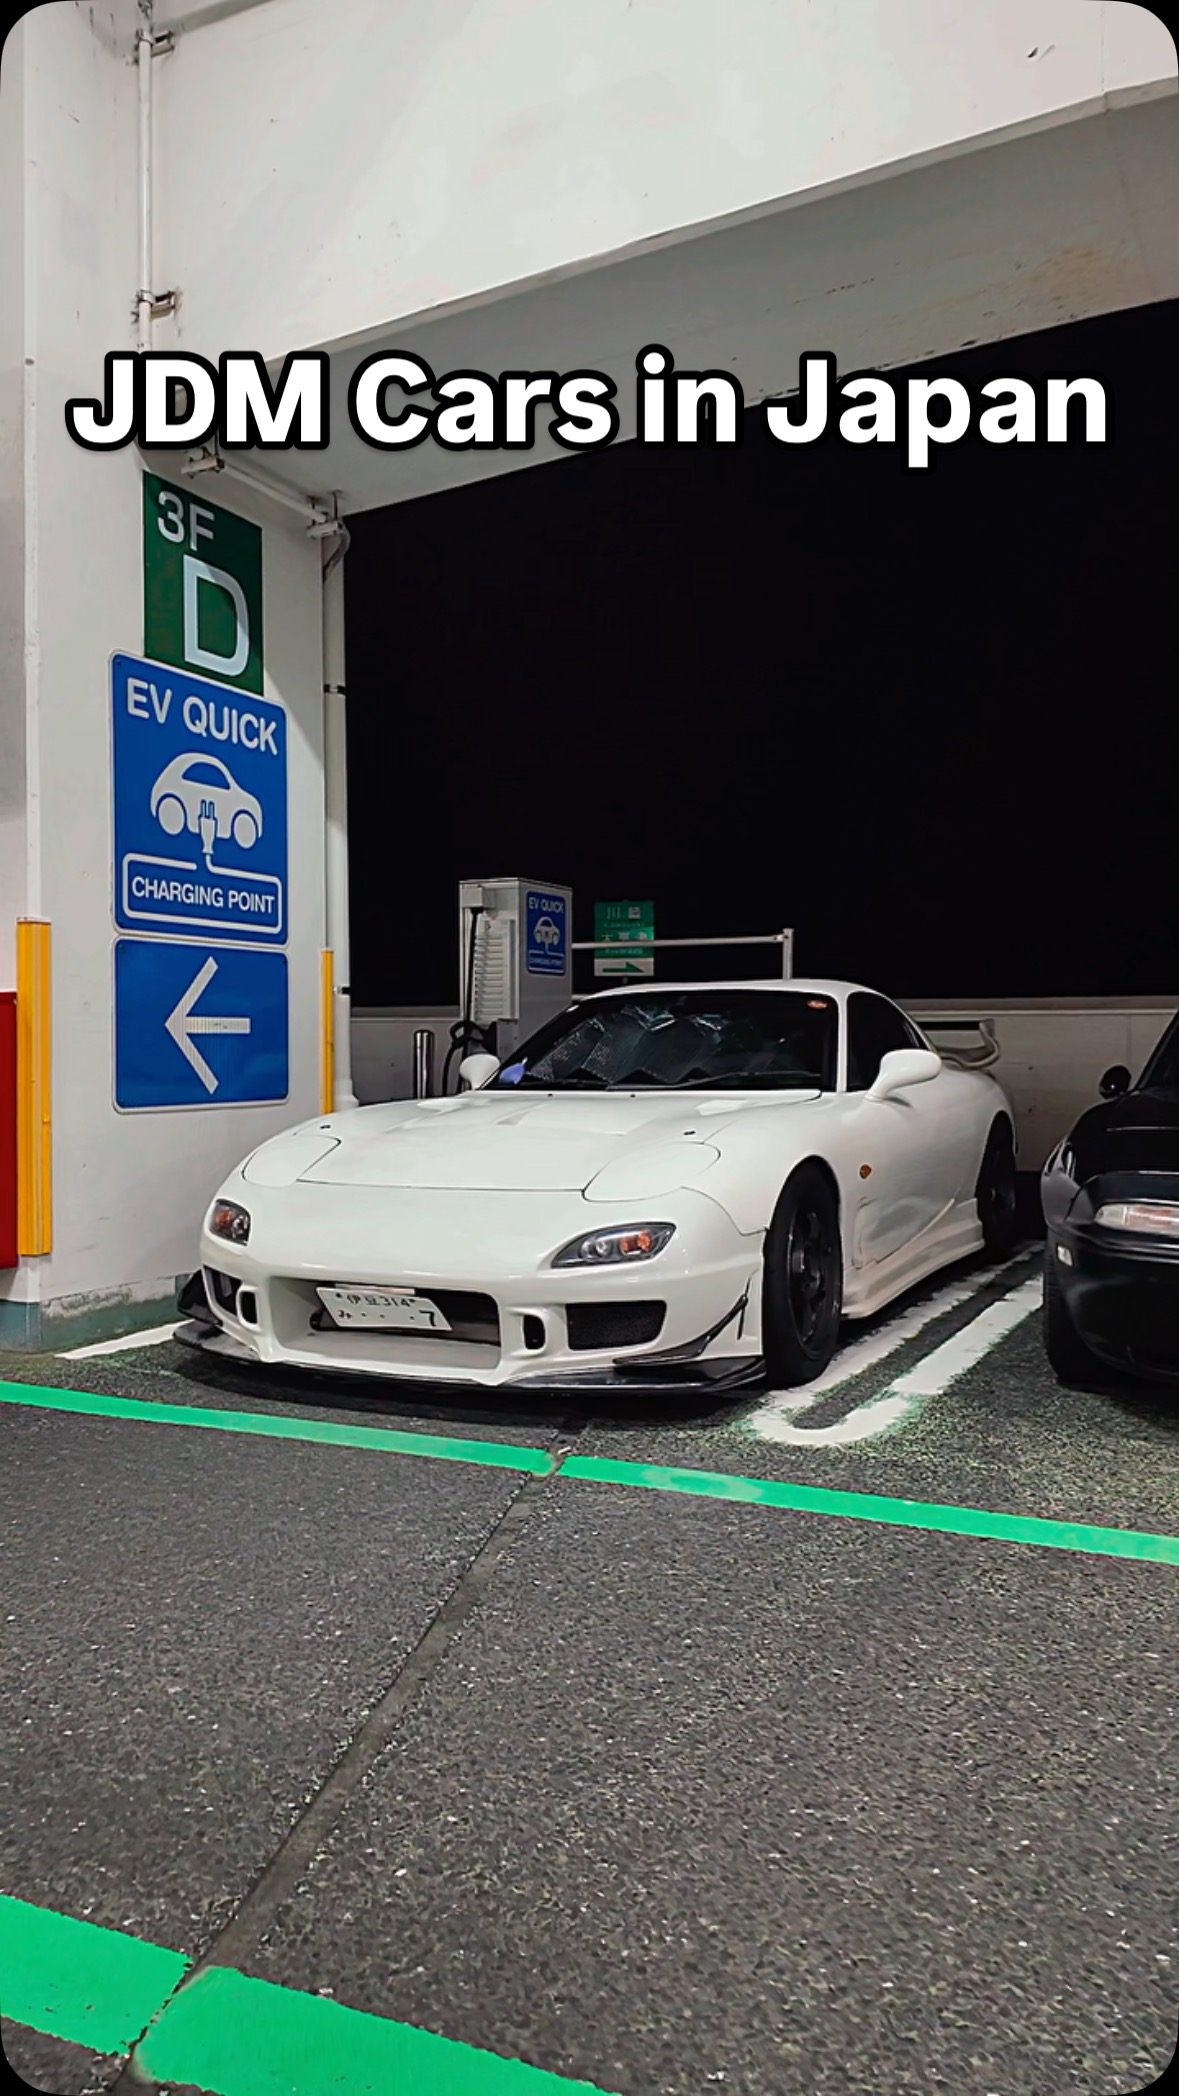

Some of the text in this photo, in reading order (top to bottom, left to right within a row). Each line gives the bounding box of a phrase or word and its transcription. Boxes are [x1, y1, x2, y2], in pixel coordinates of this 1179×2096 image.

[157, 490, 216, 551] 3F
[182, 554, 250, 677] D
[126, 677, 279, 755] EV QUICK
[131, 876, 275, 914] CHARGING POINT
[528, 896, 539, 910] EV
